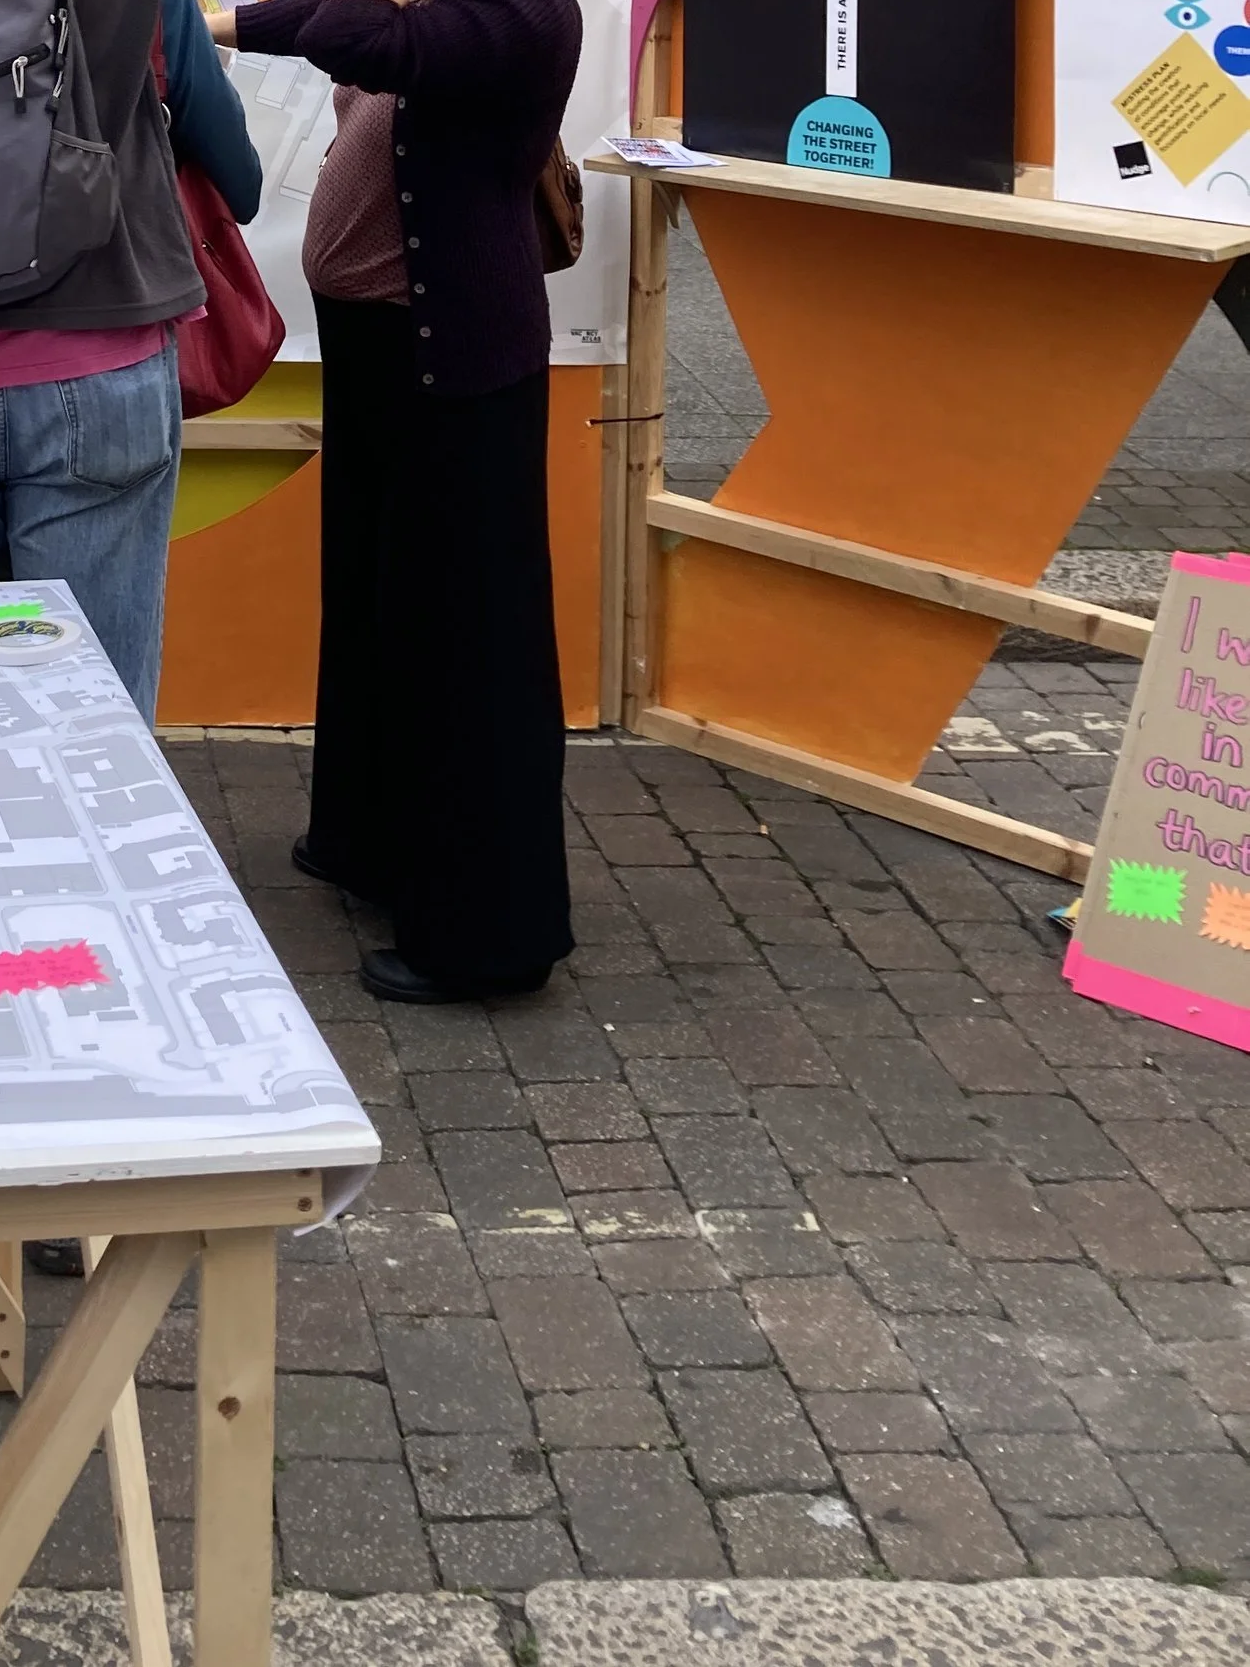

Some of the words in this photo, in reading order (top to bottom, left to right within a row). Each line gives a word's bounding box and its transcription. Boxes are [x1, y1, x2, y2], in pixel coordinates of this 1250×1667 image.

[838, 10, 847, 24] IS
[837, 26, 847, 70] THERE
[1152, 62, 1170, 79] PLAN
[806, 120, 874, 139] CHANGING
[803, 135, 827, 149] THE
[829, 138, 877, 154] STREET
[804, 150, 875, 170] TOGETHER!
[1177, 667, 1249, 726] like
[1201, 720, 1243, 768] in
